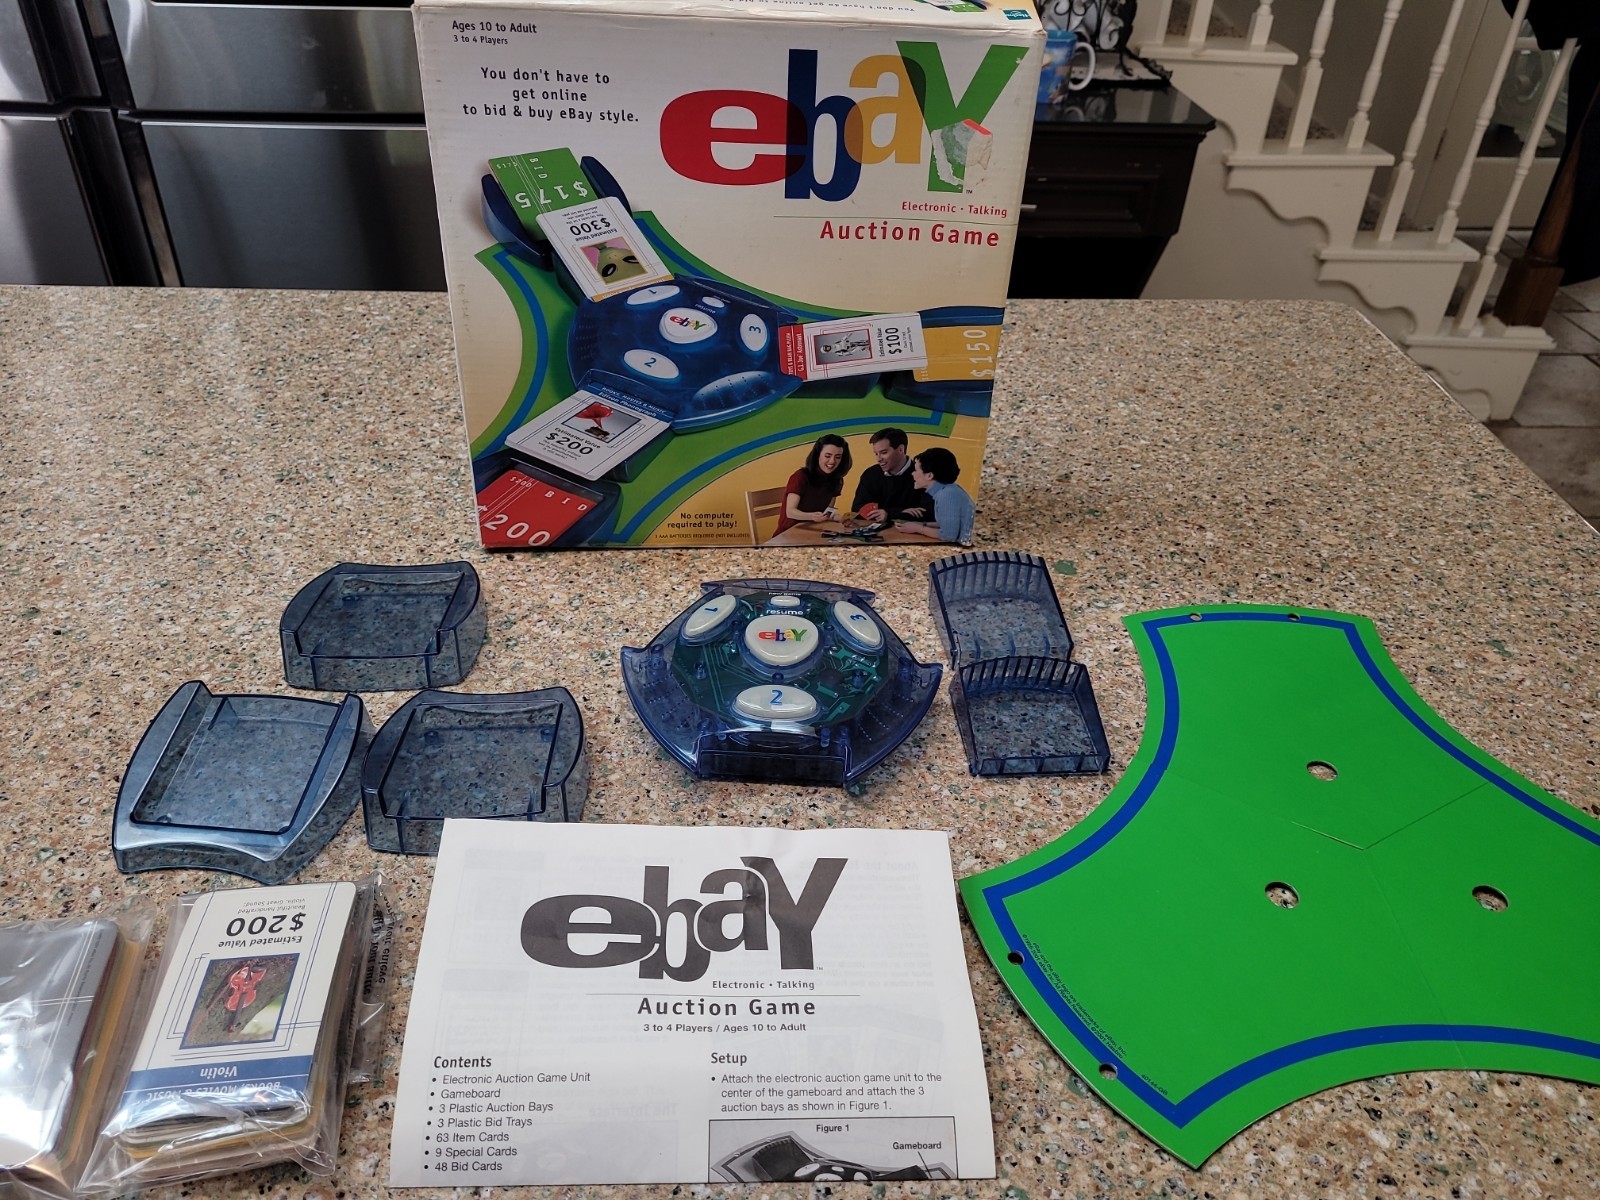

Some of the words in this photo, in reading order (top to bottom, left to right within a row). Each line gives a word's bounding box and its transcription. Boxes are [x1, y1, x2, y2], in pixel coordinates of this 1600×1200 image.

[452, 20, 476, 32] Ages
[479, 22, 492, 32] 10
[496, 23, 506, 33] to
[510, 22, 537, 34] Adult
[453, 35, 459, 43] 3
[461, 35, 470, 43] to
[472, 36, 478, 44] 4
[480, 36, 508, 45] Players
[481, 67, 506, 80] You
[513, 68, 550, 82] don't
[556, 70, 588, 83] have
[595, 72, 610, 84] to
[512, 89, 535, 102] get
[542, 89, 587, 102] online
[463, 104, 477, 116] to
[484, 104, 506, 117] bid
[513, 106, 522, 117] &
[528, 106, 553, 121] buy
[560, 109, 593, 123] eBay
[599, 110, 640, 124] style.
[514, 180, 588, 209] $175
[901, 201, 957, 214] Electronic
[968, 204, 1008, 219] Talking
[569, 217, 611, 236] $300
[820, 220, 921, 242] Auction
[930, 223, 1000, 248] Game
[748, 325, 762, 334] 3
[885, 327, 903, 355] $100
[963, 329, 993, 378] $150
[644, 357, 657, 368] 2
[544, 431, 594, 456] $200
[544, 490, 588, 512] BID
[680, 512, 692, 520] No
[694, 512, 735, 521] computer
[667, 520, 703, 529] required
[716, 520, 738, 529] play!
[849, 613, 868, 623] 3
[769, 689, 784, 705] 2
[226, 912, 307, 937] $200
[218, 938, 246, 948] Value
[249, 935, 303, 947] Estimated
[712, 980, 765, 990] Electronic
[777, 979, 815, 991] Talking
[637, 997, 738, 1016] Auction
[749, 998, 816, 1016] Game
[643, 1023, 650, 1032] 3
[652, 1023, 664, 1032] to
[666, 1023, 673, 1032] 4
[675, 1023, 714, 1034] Players
[722, 1023, 749, 1034] Ages
[752, 1023, 763, 1032] 10
[766, 1023, 777, 1032] to
[779, 1023, 806, 1032] Adult
[433, 1055, 492, 1069] Contents
[710, 1052, 748, 1067] Setup
[199, 1064, 238, 1080] Violin
[442, 1074, 493, 1085] Electronic
[495, 1073, 535, 1084] Auction
[537, 1073, 567, 1083] Game
[570, 1072, 591, 1082] Unit
[721, 1073, 753, 1084] Attach
[756, 1073, 773, 1083] the
[774, 1073, 822, 1083] electronic
[825, 1073, 861, 1083] auction
[863, 1074, 891, 1085] game
[893, 1072, 912, 1083] unit
[913, 1073, 924, 1083] to
[926, 1072, 943, 1082] the
[440, 1088, 501, 1100] Gameboard
[721, 1088, 753, 1098] center
[755, 1087, 766, 1098] of
[767, 1087, 784, 1098] the
[786, 1086, 843, 1100] gameboard
[845, 1086, 864, 1097] and
[866, 1086, 897, 1096] attach
[899, 1086, 916, 1096] the
[918, 1086, 925, 1096] 3
[438, 1103, 446, 1114] 3
[449, 1103, 484, 1113] Plastic
[486, 1102, 526, 1113] Auction
[528, 1102, 554, 1114] Bays
[720, 1102, 758, 1113] auction
[760, 1101, 785, 1115] bays
[786, 1103, 799, 1112] as
[801, 1101, 835, 1112] shown
[837, 1101, 846, 1111] in
[849, 1100, 880, 1113] Figure
[882, 1100, 892, 1111] 1.
[437, 1118, 444, 1128] 3
[447, 1117, 482, 1128] Plastic
[485, 1116, 503, 1127] Bid
[504, 1116, 533, 1129] Trays
[815, 1124, 843, 1135] Figure
[845, 1124, 850, 1133] 1
[435, 1132, 449, 1143] 63
[452, 1132, 476, 1143] Item
[478, 1131, 510, 1143] Cards
[435, 1147, 442, 1157] 9
[444, 1146, 484, 1159] Special
[486, 1146, 518, 1157] Cards
[892, 1141, 942, 1151] Gameboard
[434, 1162, 448, 1172] 48
[450, 1161, 468, 1172] Bid
[471, 1160, 503, 1172] Cards
